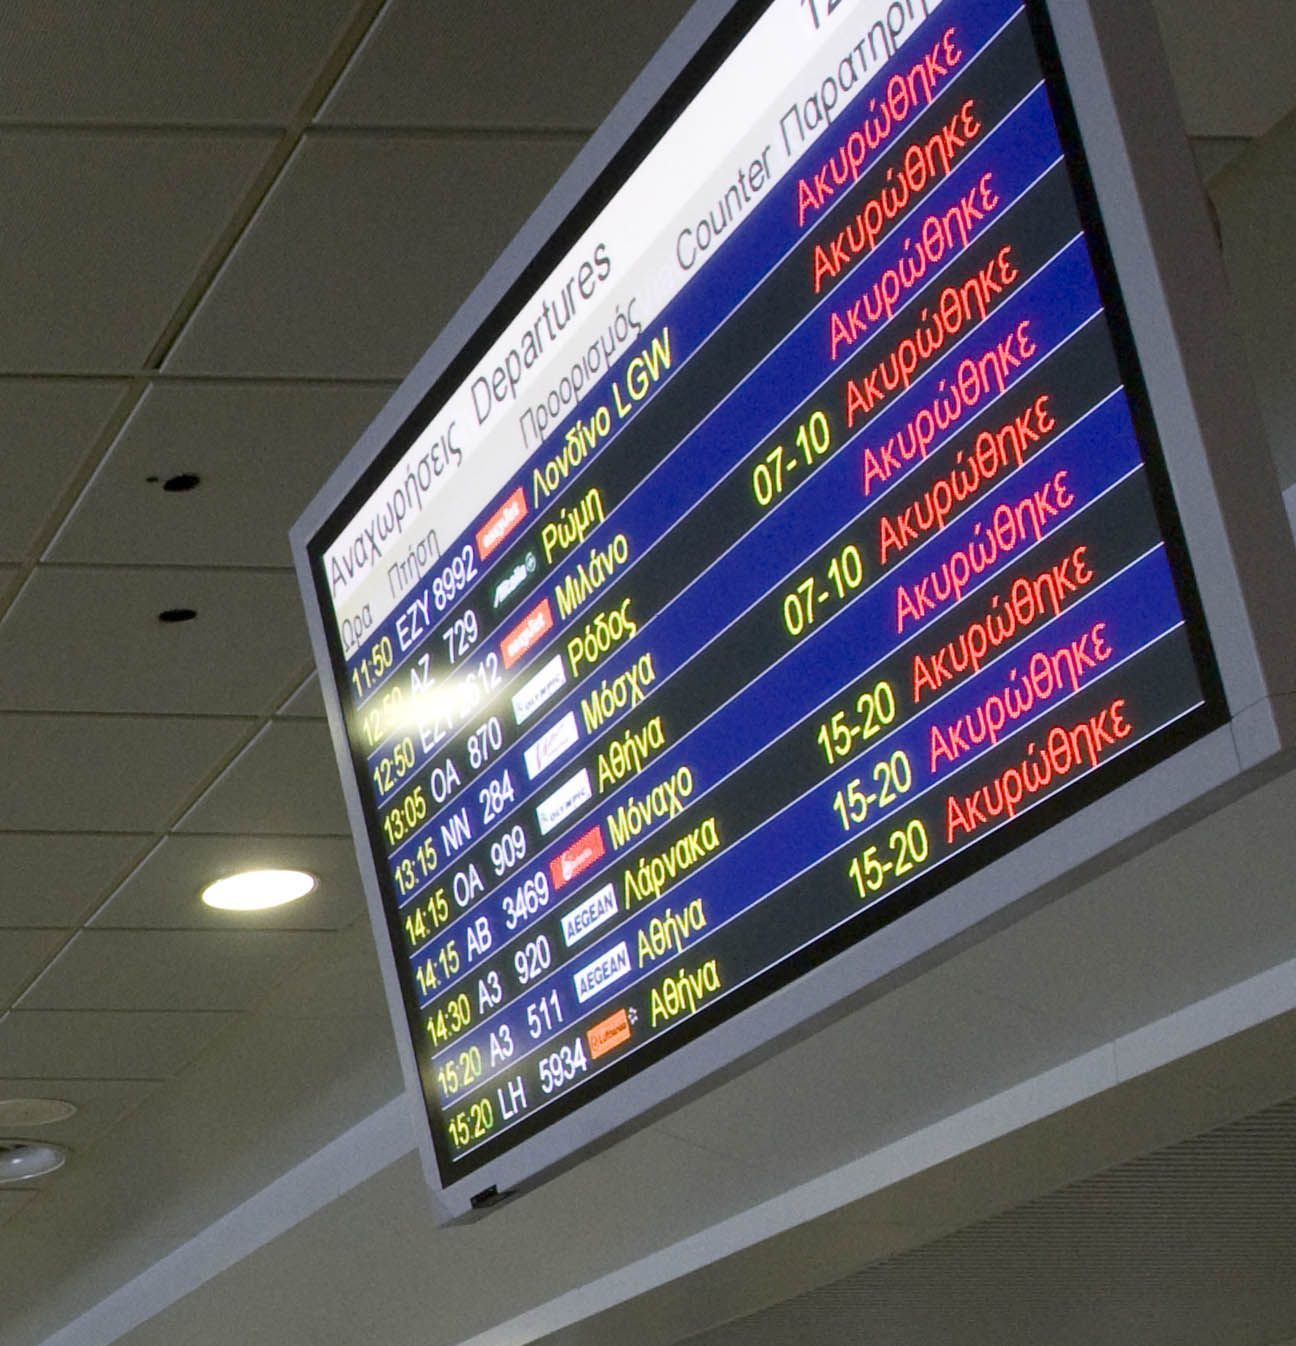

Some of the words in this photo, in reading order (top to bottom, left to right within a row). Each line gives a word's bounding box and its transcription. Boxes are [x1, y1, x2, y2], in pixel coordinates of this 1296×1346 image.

[329, 422, 463, 597] Αναχωρήσεις
[471, 243, 610, 425] Departures
[352, 636, 393, 697] 11:50
[395, 590, 430, 652] EZY
[433, 545, 478, 611] 8992
[533, 406, 611, 509] Λονδίνο
[612, 326, 672, 419] LGW
[797, 26, 962, 228] Ακυρώθηκε
[373, 737, 415, 796] 12:50
[554, 533, 629, 620] Μιλάνο
[828, 172, 1000, 361] Ακυρώθηκε
[383, 786, 427, 846] 13:05
[430, 759, 461, 803] OA
[467, 717, 503, 769] 870
[567, 598, 637, 678] Ρόδος
[752, 411, 831, 506] 07-10
[846, 245, 1019, 428] Ακυρώθηκε
[388, 529, 442, 599] Πτήση
[519, 297, 642, 449] Προορισμός
[676, 145, 771, 271] Counter
[394, 837, 438, 896] 13:15
[441, 807, 473, 857] NN
[479, 769, 516, 825] 284
[580, 651, 657, 735] Μόσχα
[862, 320, 1037, 497] Ακυρώθηκε
[443, 610, 478, 664] 729
[541, 488, 606, 565] Ρώμη
[812, 99, 981, 294] Ακυρώθηκε
[405, 888, 450, 946] 14:15
[453, 863, 485, 908] OA
[490, 825, 527, 876] 909
[598, 717, 666, 793] Αθήνα
[783, 544, 863, 636] 07-10
[880, 395, 1056, 565] Ακυρώθηκε
[415, 940, 460, 996] 14:15
[466, 916, 493, 963] AB
[502, 871, 549, 930] 3469
[607, 766, 694, 850] Μόναχο
[895, 470, 1076, 635] Ακυρώθηκε
[426, 993, 472, 1047] 14:30
[478, 970, 503, 1015] A3
[514, 934, 551, 985] 920
[566, 890, 614, 940] AEGEAN
[624, 816, 720, 910] Λάρνακα
[817, 681, 896, 765] 15-20
[912, 545, 1094, 704] Ακυρώθηκε
[438, 1045, 482, 1098] 15:20
[489, 1023, 515, 1067] A3
[526, 989, 564, 1040] 511
[578, 950, 628, 998] AEGEAN
[637, 898, 707, 969] Αθήνα
[832, 749, 913, 831] 15-20
[929, 622, 1113, 774] Ακυρώθηκε
[448, 1098, 494, 1149] 15:20
[497, 1075, 528, 1121] LH
[539, 1037, 588, 1094] 5934
[650, 959, 721, 1028] Αθήνα
[848, 818, 930, 899] 15-20
[945, 699, 1133, 844] Ακυρώθηκε
